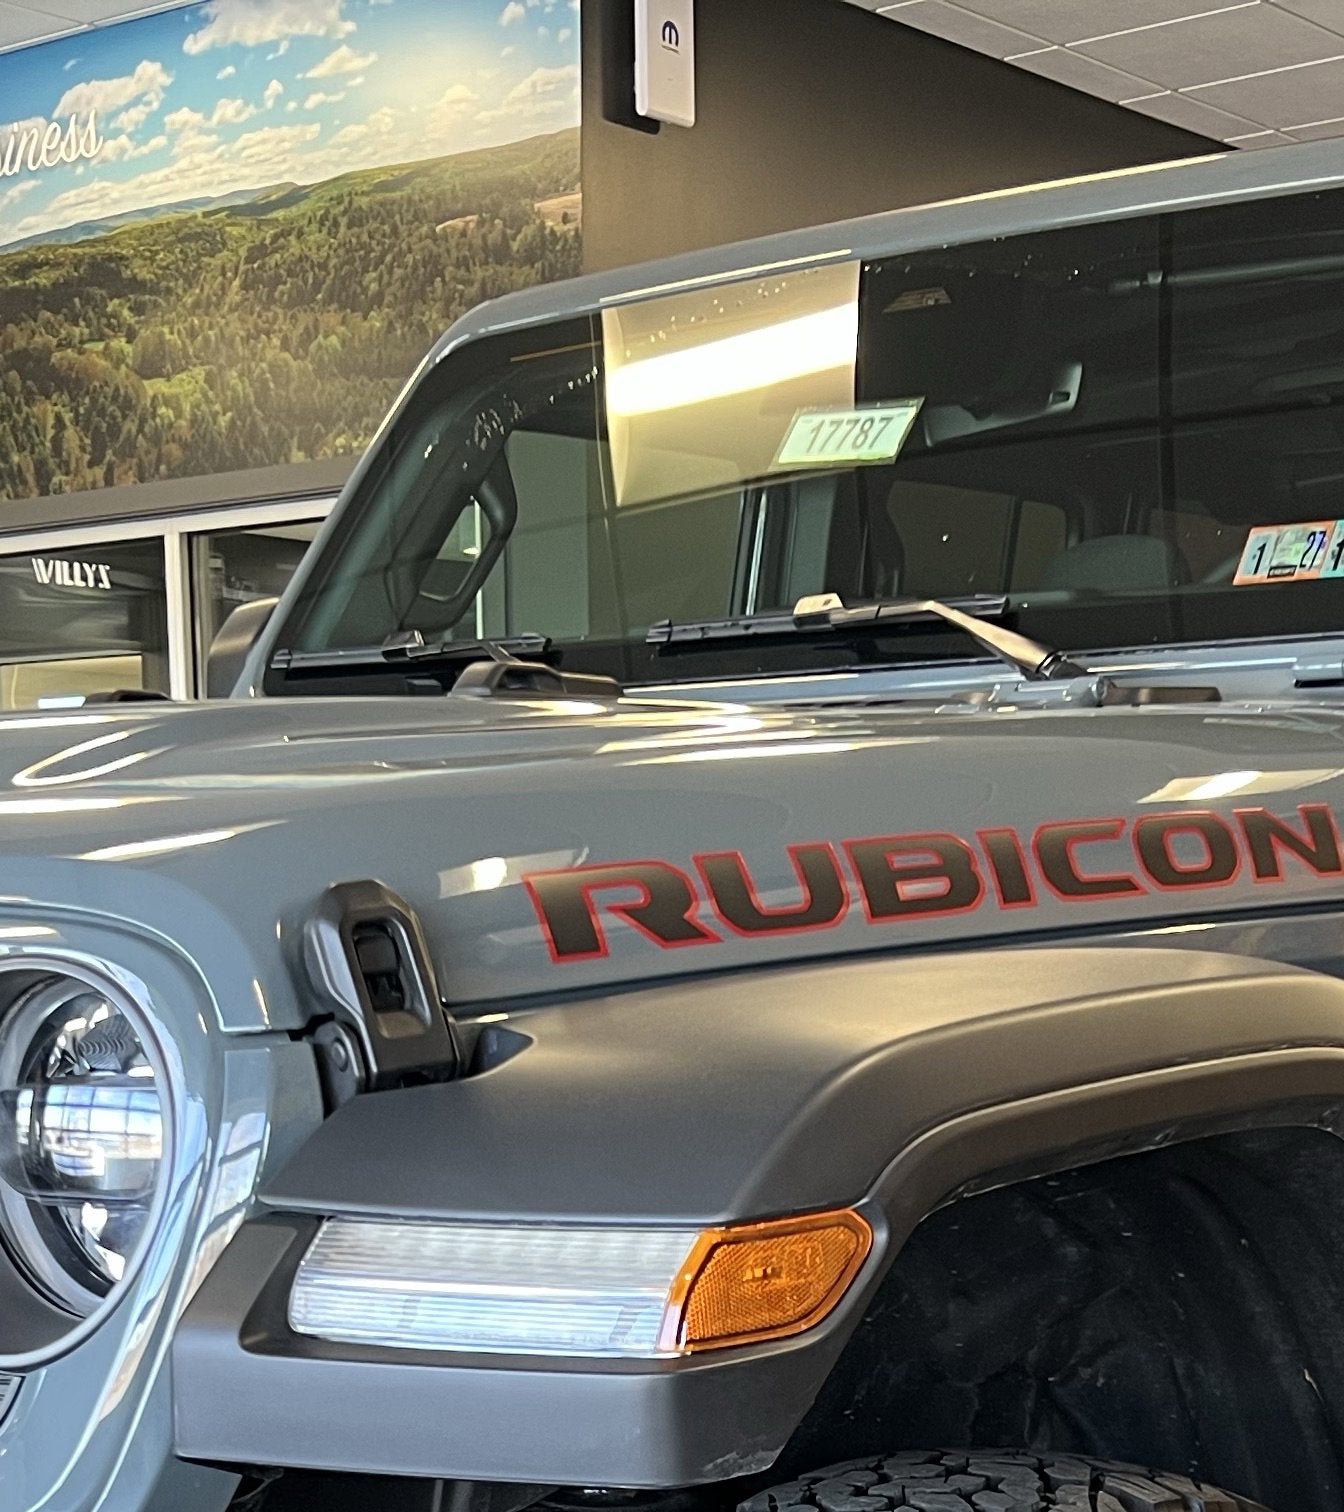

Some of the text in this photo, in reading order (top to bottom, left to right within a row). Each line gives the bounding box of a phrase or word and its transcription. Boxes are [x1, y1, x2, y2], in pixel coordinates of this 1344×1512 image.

[807, 416, 894, 454] 17787
[1299, 530, 1327, 571] 27
[31, 556, 112, 590] WILLYS
